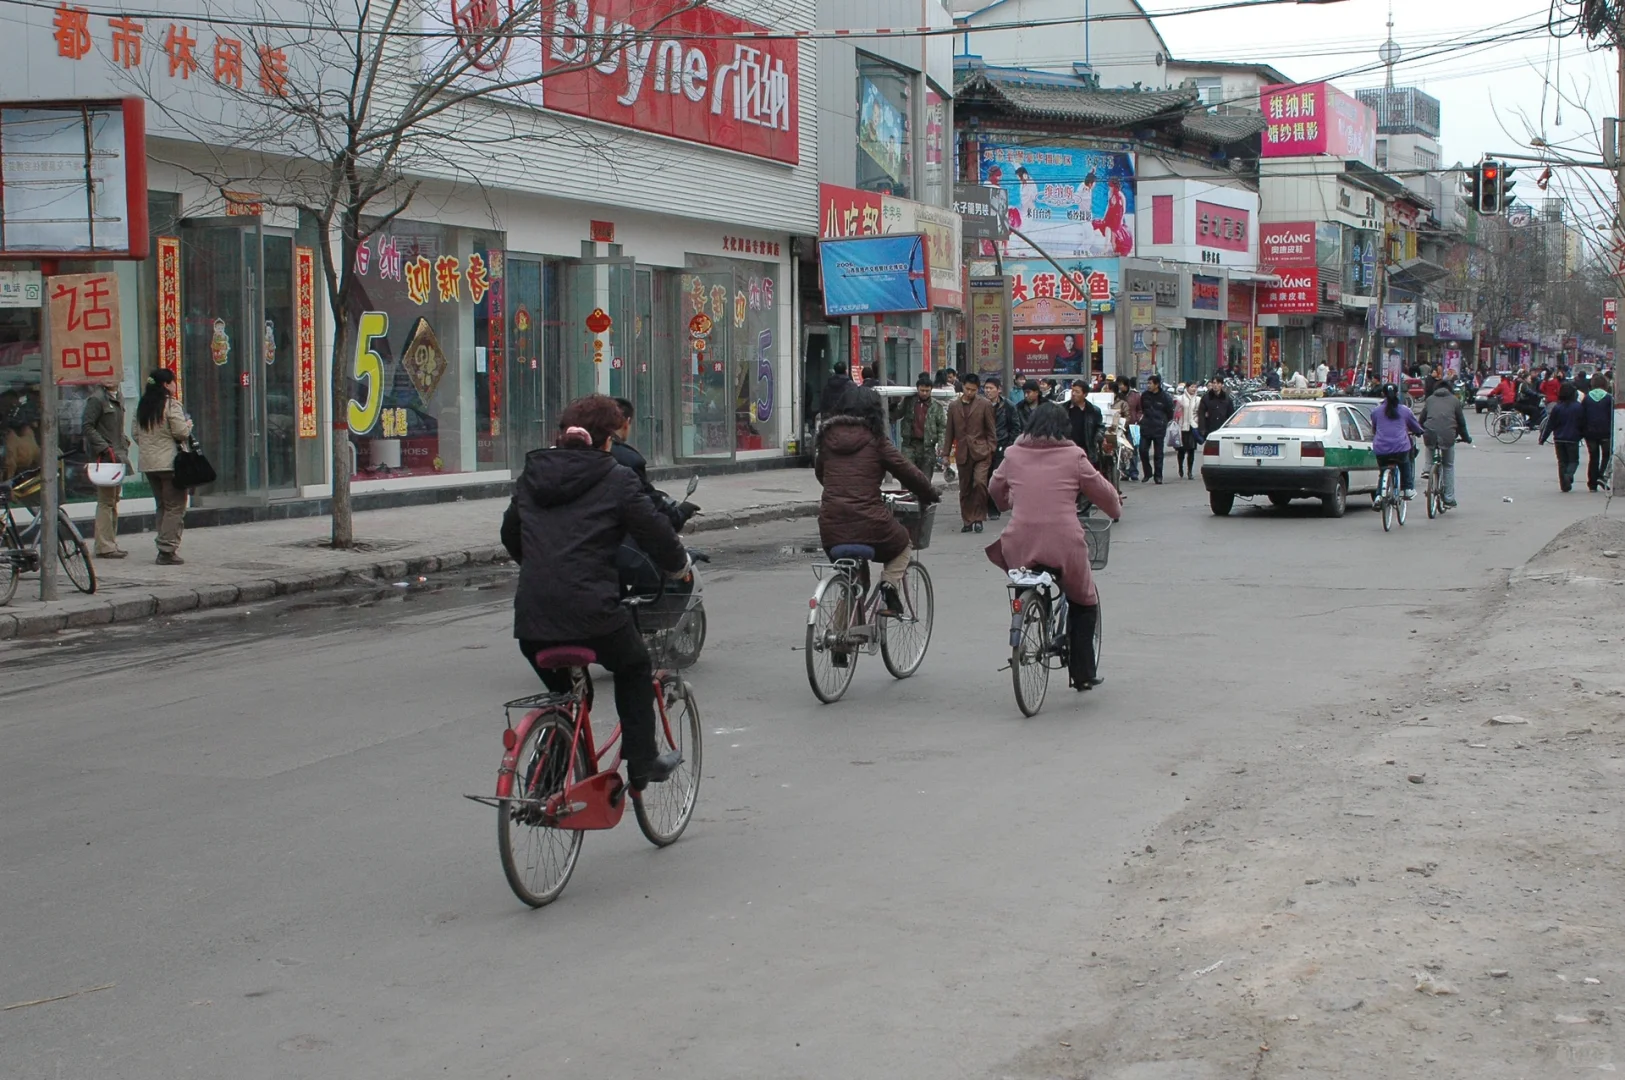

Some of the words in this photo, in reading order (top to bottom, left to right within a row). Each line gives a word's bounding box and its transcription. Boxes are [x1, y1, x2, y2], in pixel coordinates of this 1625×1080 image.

[53, 1, 291, 97] 都市休闲鞋
[548, 0, 695, 106] Buyne
[1267, 121, 1318, 144] 婚纱摄影
[1269, 92, 1315, 119] 维纳斯
[1265, 231, 1311, 245] AOKANG
[50, 277, 112, 332] 话
[404, 252, 490, 306] 迎新春
[61, 342, 114, 376] 吧
[346, 311, 389, 435] 5
